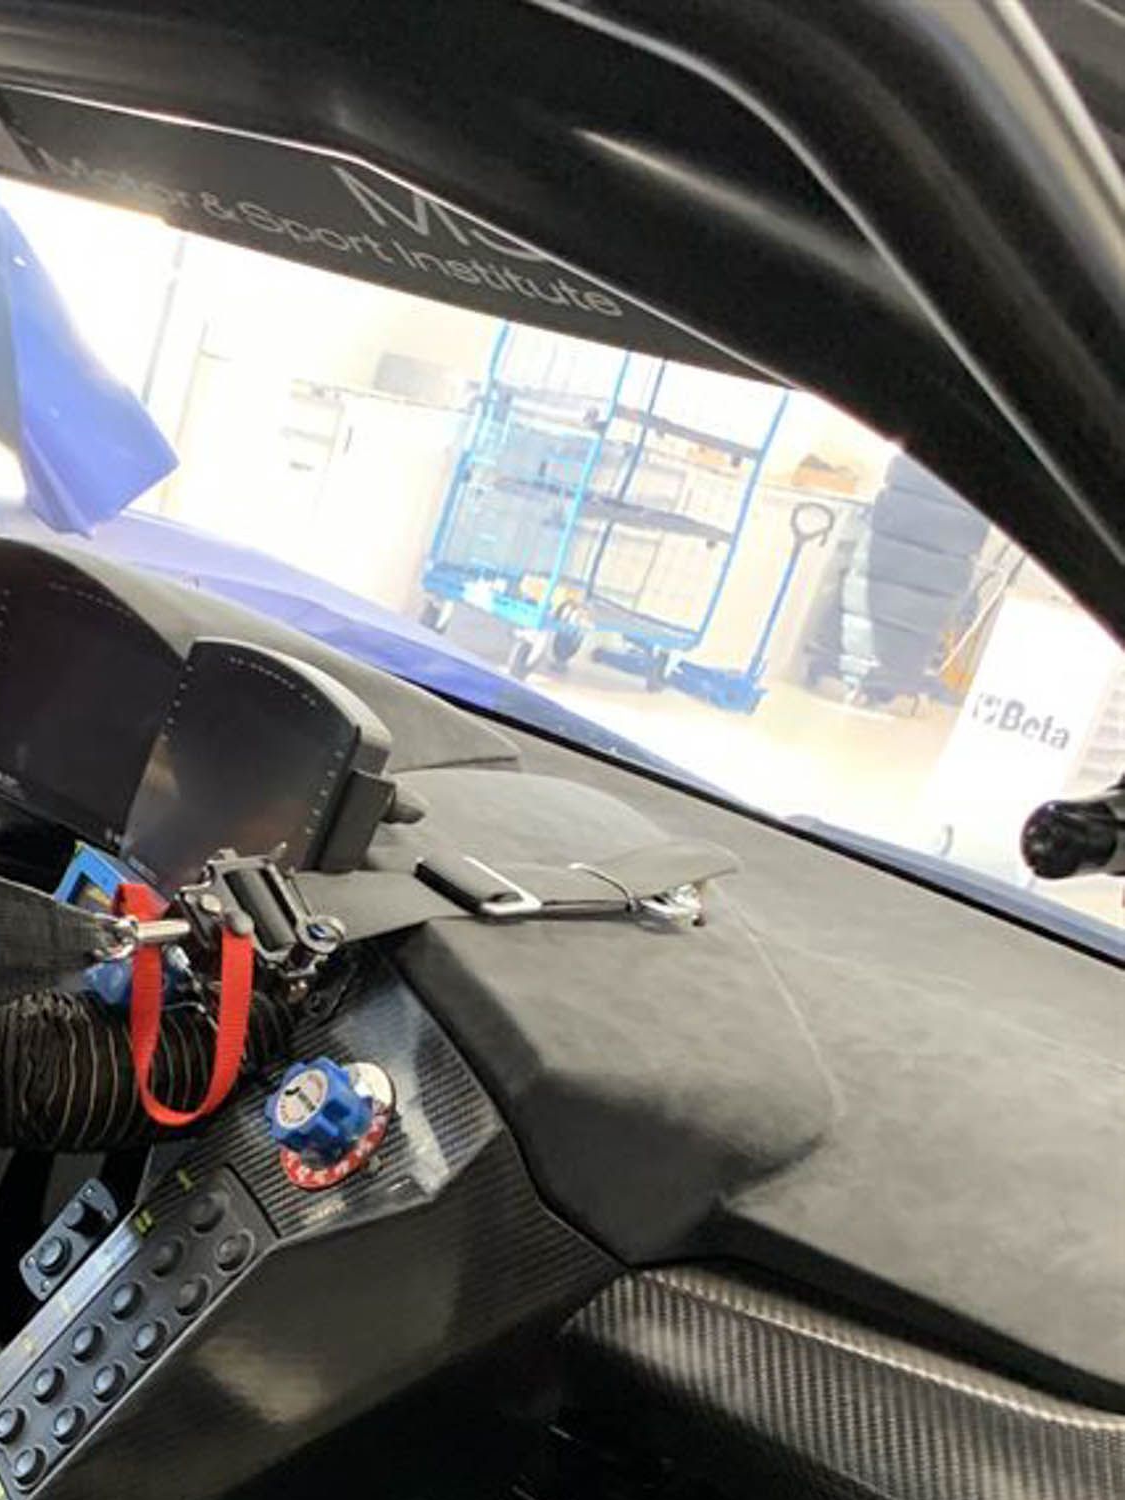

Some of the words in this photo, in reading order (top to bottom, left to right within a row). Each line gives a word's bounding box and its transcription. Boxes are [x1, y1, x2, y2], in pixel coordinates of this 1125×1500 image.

[199, 191, 241, 224] &
[237, 200, 395, 265] Sport
[391, 239, 625, 317] Institute
